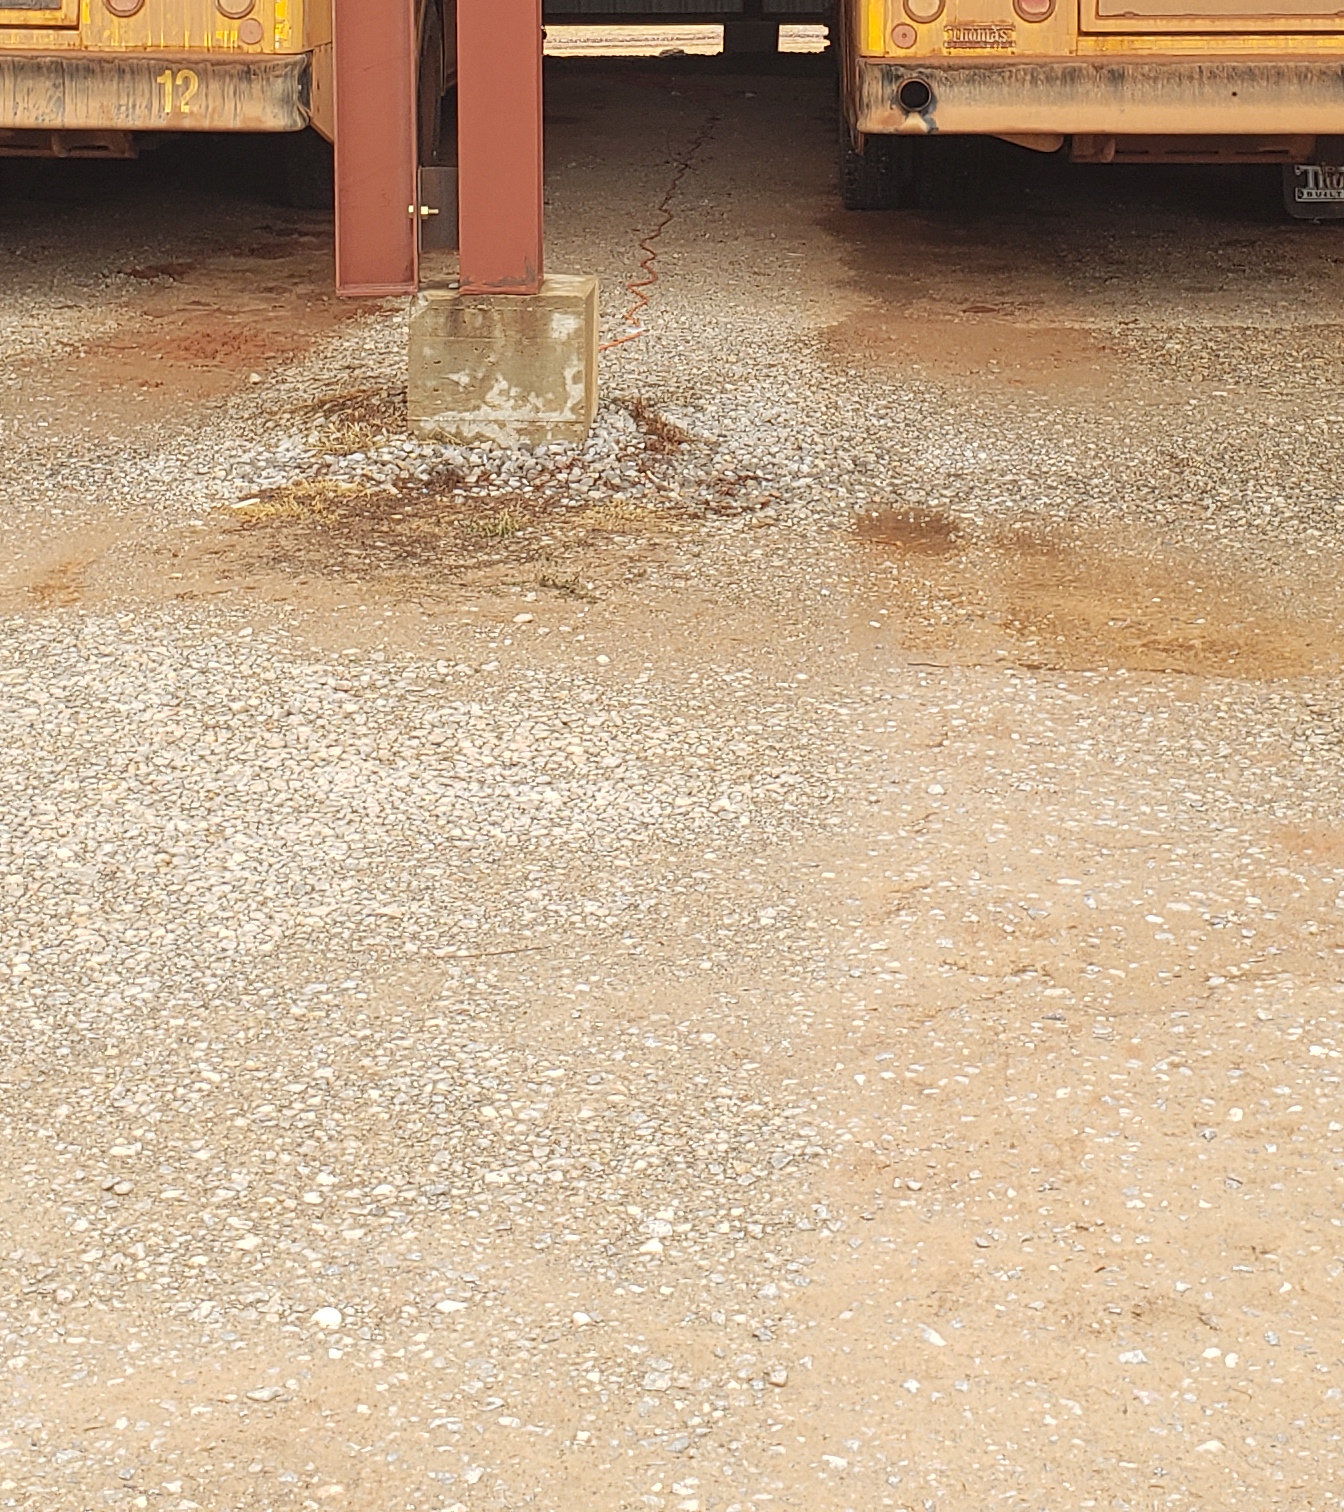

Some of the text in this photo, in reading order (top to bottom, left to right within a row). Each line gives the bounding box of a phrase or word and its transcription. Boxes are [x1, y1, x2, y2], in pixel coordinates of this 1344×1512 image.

[945, 25, 1013, 42] Thomas
[157, 69, 199, 113] 12
[1306, 190, 1343, 198] BUILT
